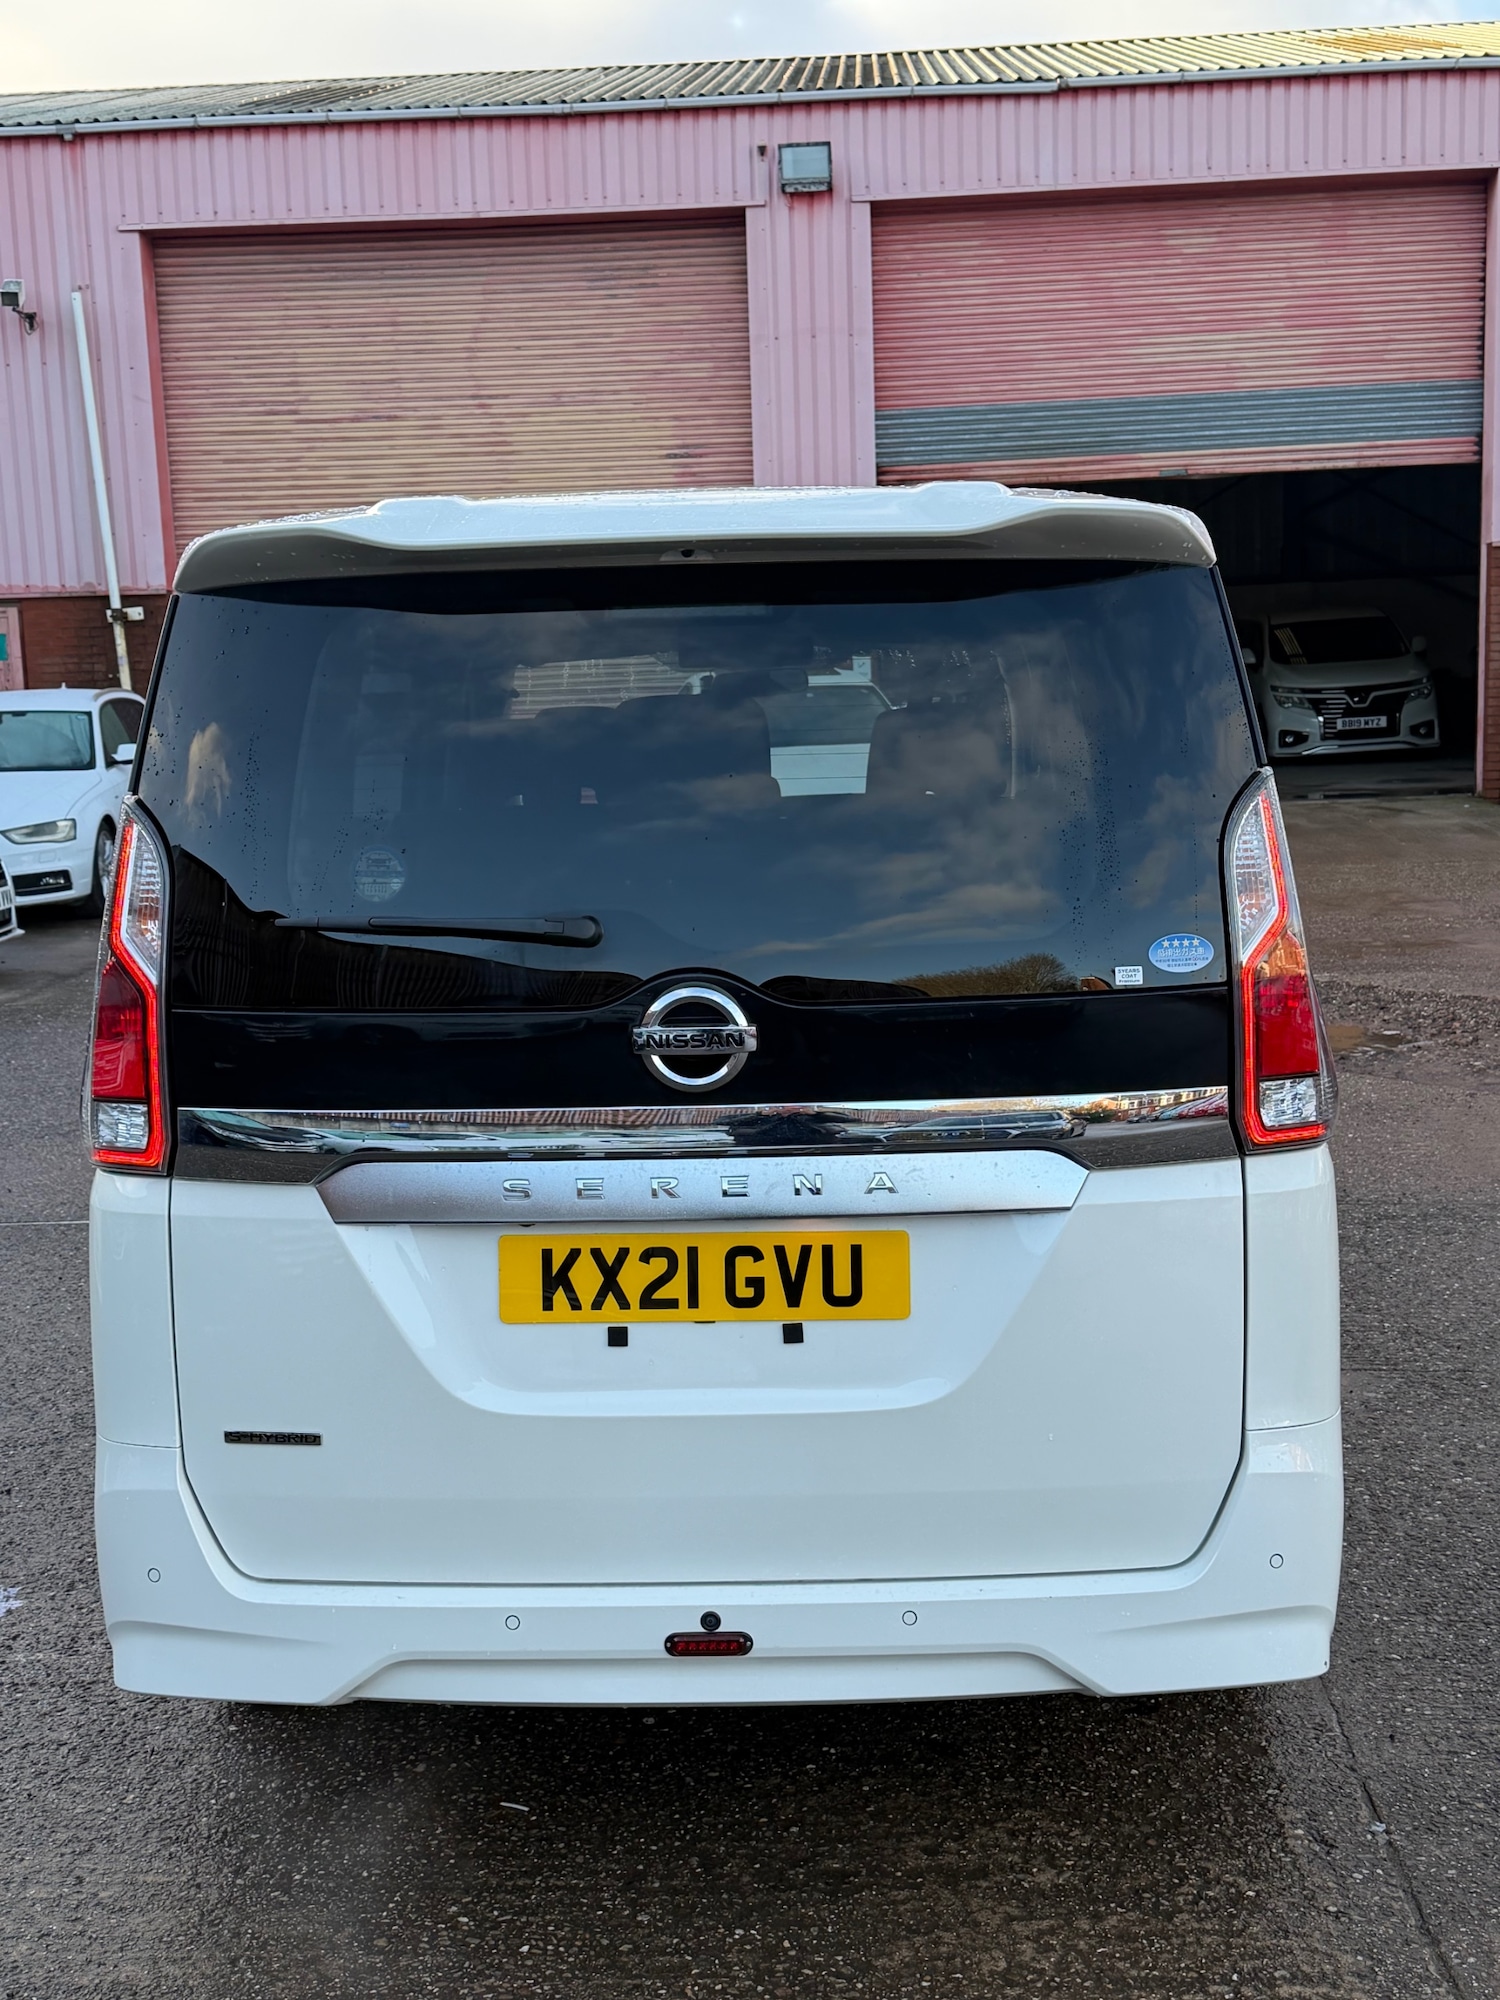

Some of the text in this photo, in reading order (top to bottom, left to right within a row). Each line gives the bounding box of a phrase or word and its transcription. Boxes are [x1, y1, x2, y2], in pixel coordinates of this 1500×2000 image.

[1342, 719, 1361, 728] BB19
[645, 1032, 745, 1049] NISSAN
[502, 1172, 899, 1201] SERENA
[541, 1244, 863, 1311] KX21 GVU
[228, 1432, 317, 1444] S-HYBRID
